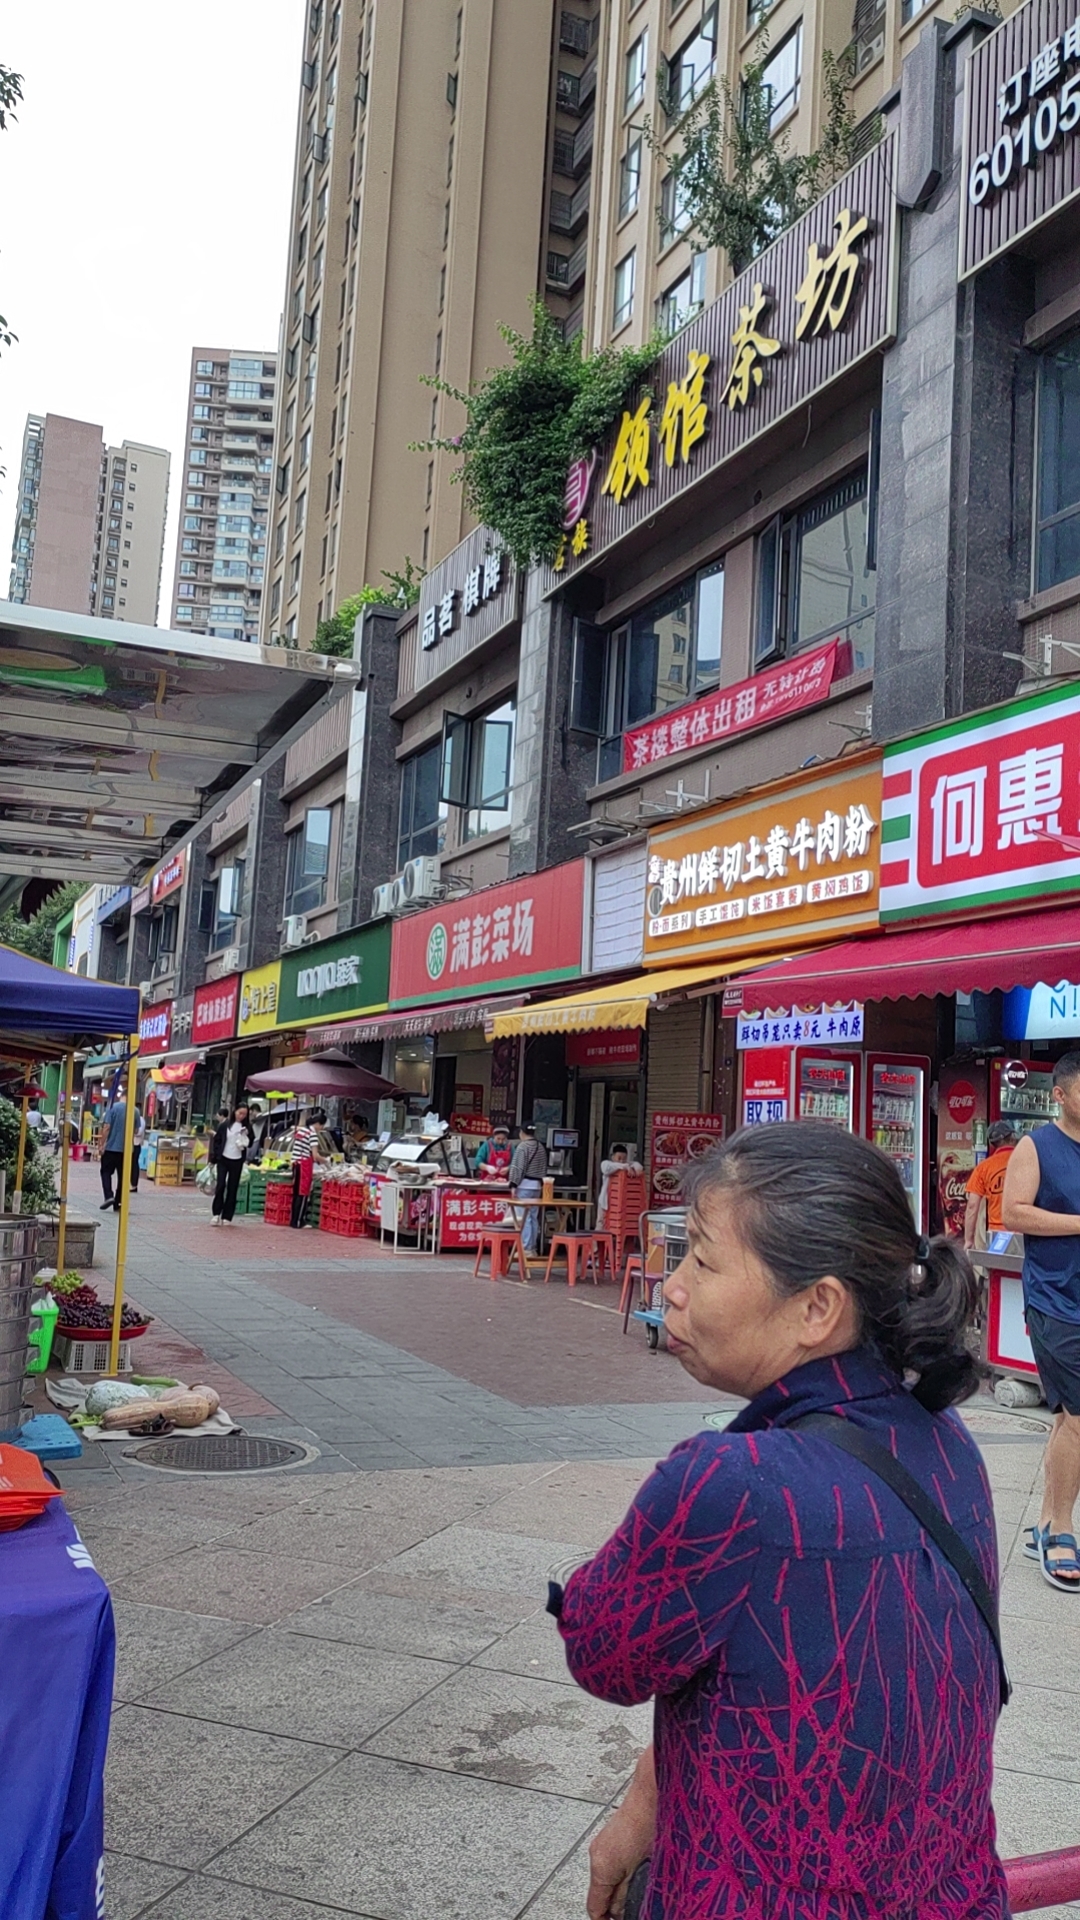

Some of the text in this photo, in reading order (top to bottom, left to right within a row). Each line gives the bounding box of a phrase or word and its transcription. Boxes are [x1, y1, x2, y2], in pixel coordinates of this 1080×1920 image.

[422, 549, 501, 651] 品茗棋牌
[632, 686, 758, 769] 茶楼整体出租
[660, 803, 876, 905] 贵州鲜切土黄牛肉粉
[751, 887, 799, 912] 米饭套餐
[811, 873, 865, 900] 黄焖鸡饭
[449, 898, 534, 974] 满彭菜场
[445, 1198, 508, 1217] 满彭牛肉
